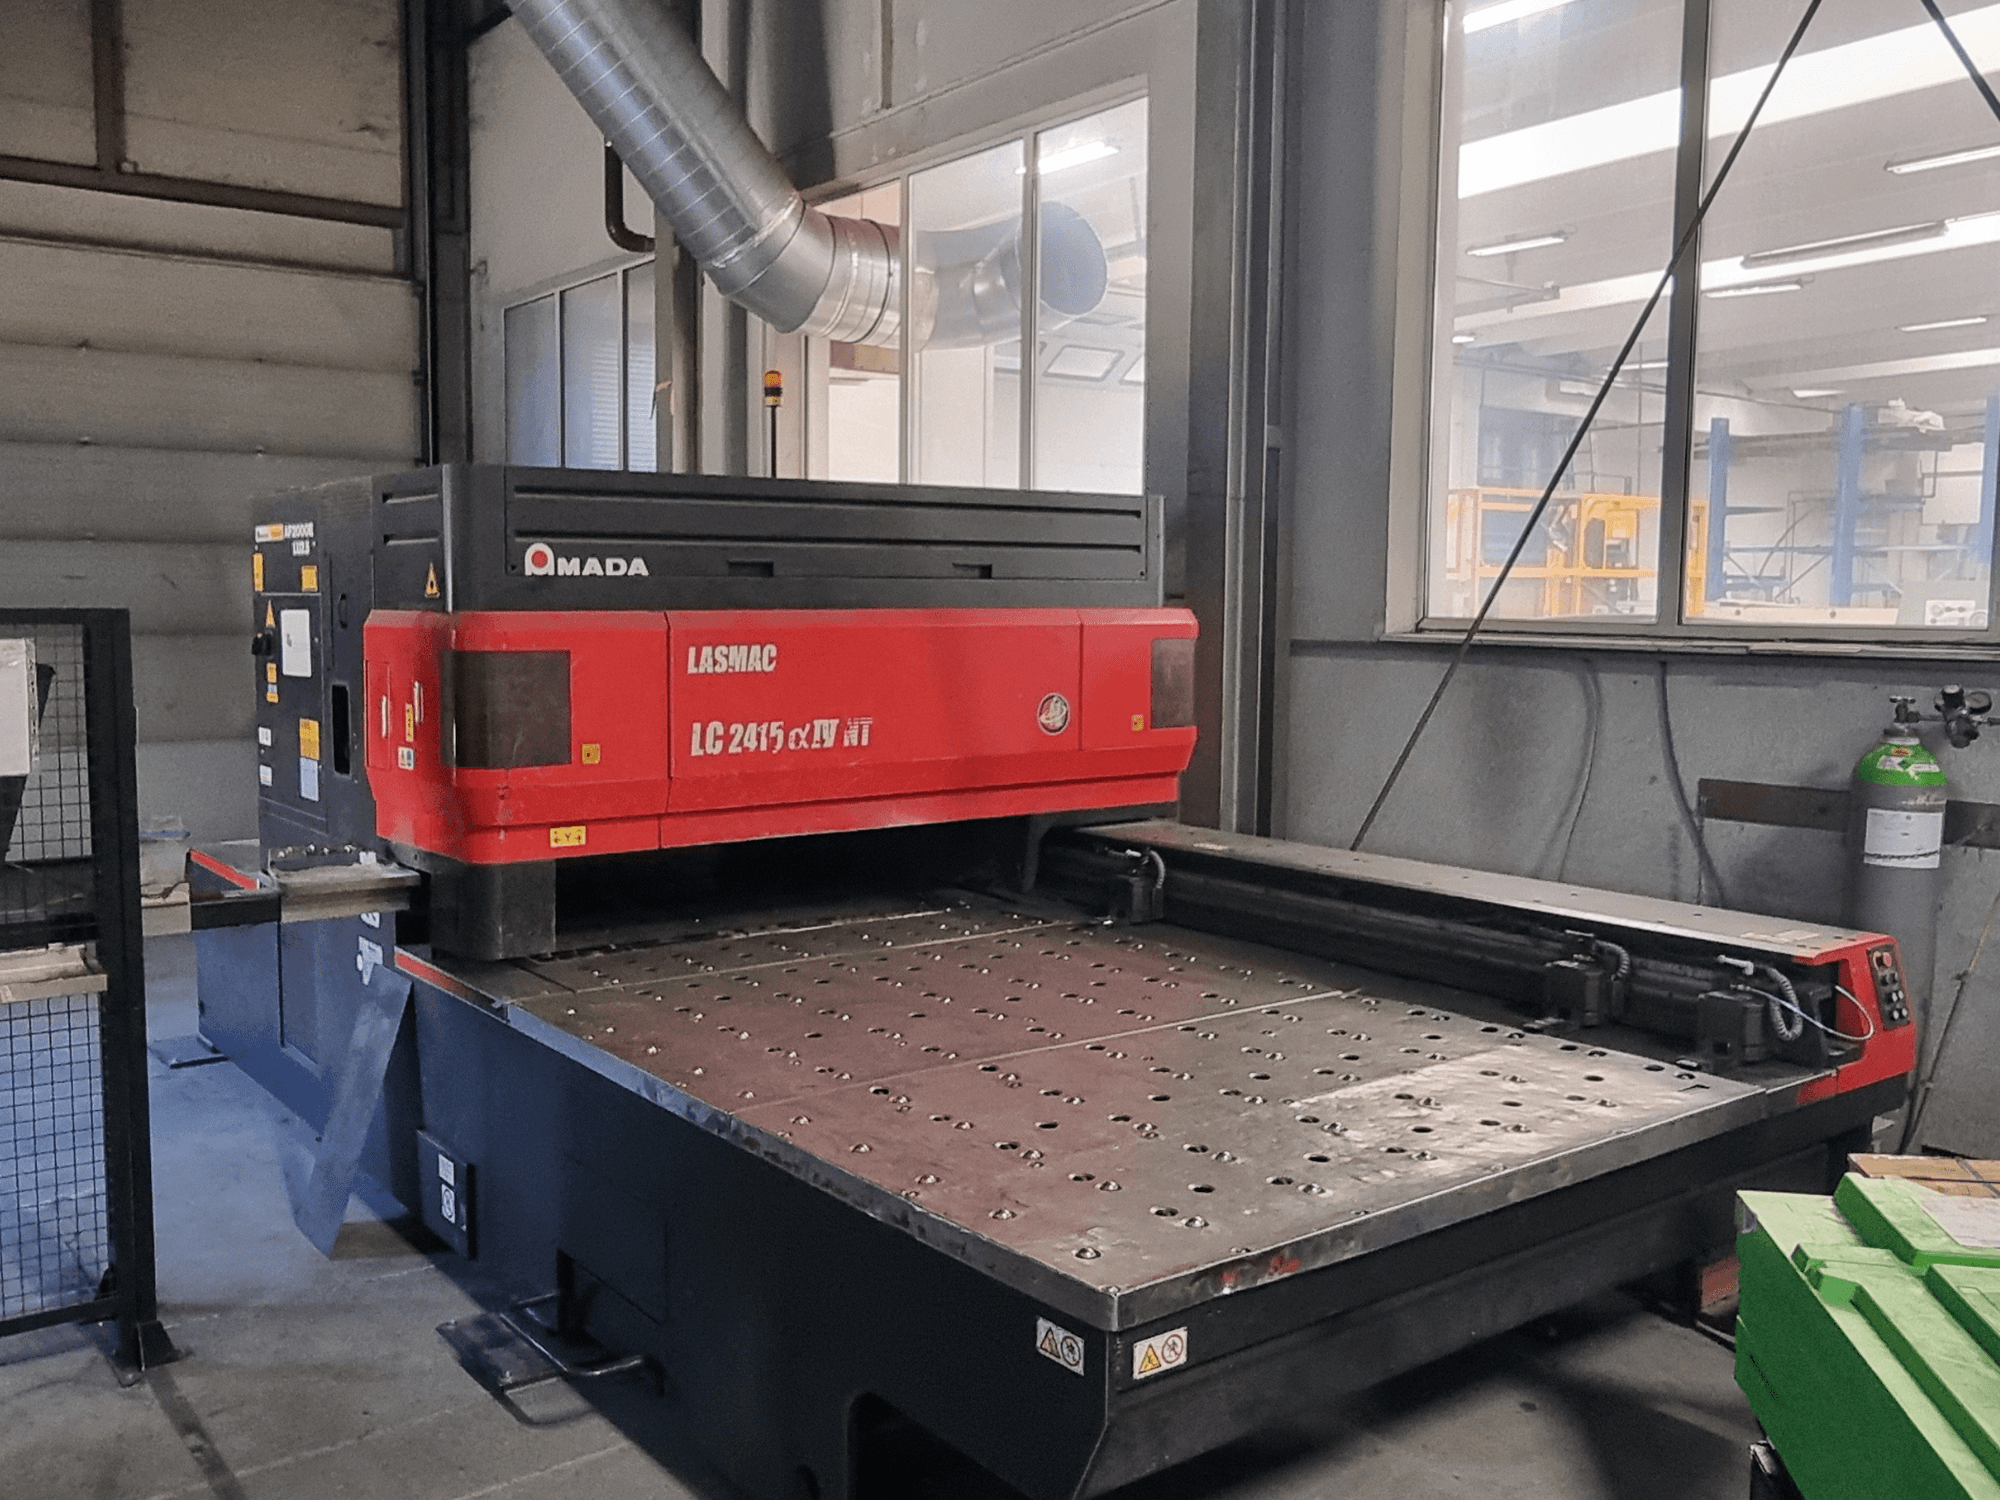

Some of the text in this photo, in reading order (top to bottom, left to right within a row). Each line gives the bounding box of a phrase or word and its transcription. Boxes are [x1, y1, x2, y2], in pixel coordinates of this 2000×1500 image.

[524, 542, 650, 576] AMADA
[687, 643, 778, 675] LASMAC
[690, 720, 725, 757] LC
[728, 720, 785, 755] 2415
